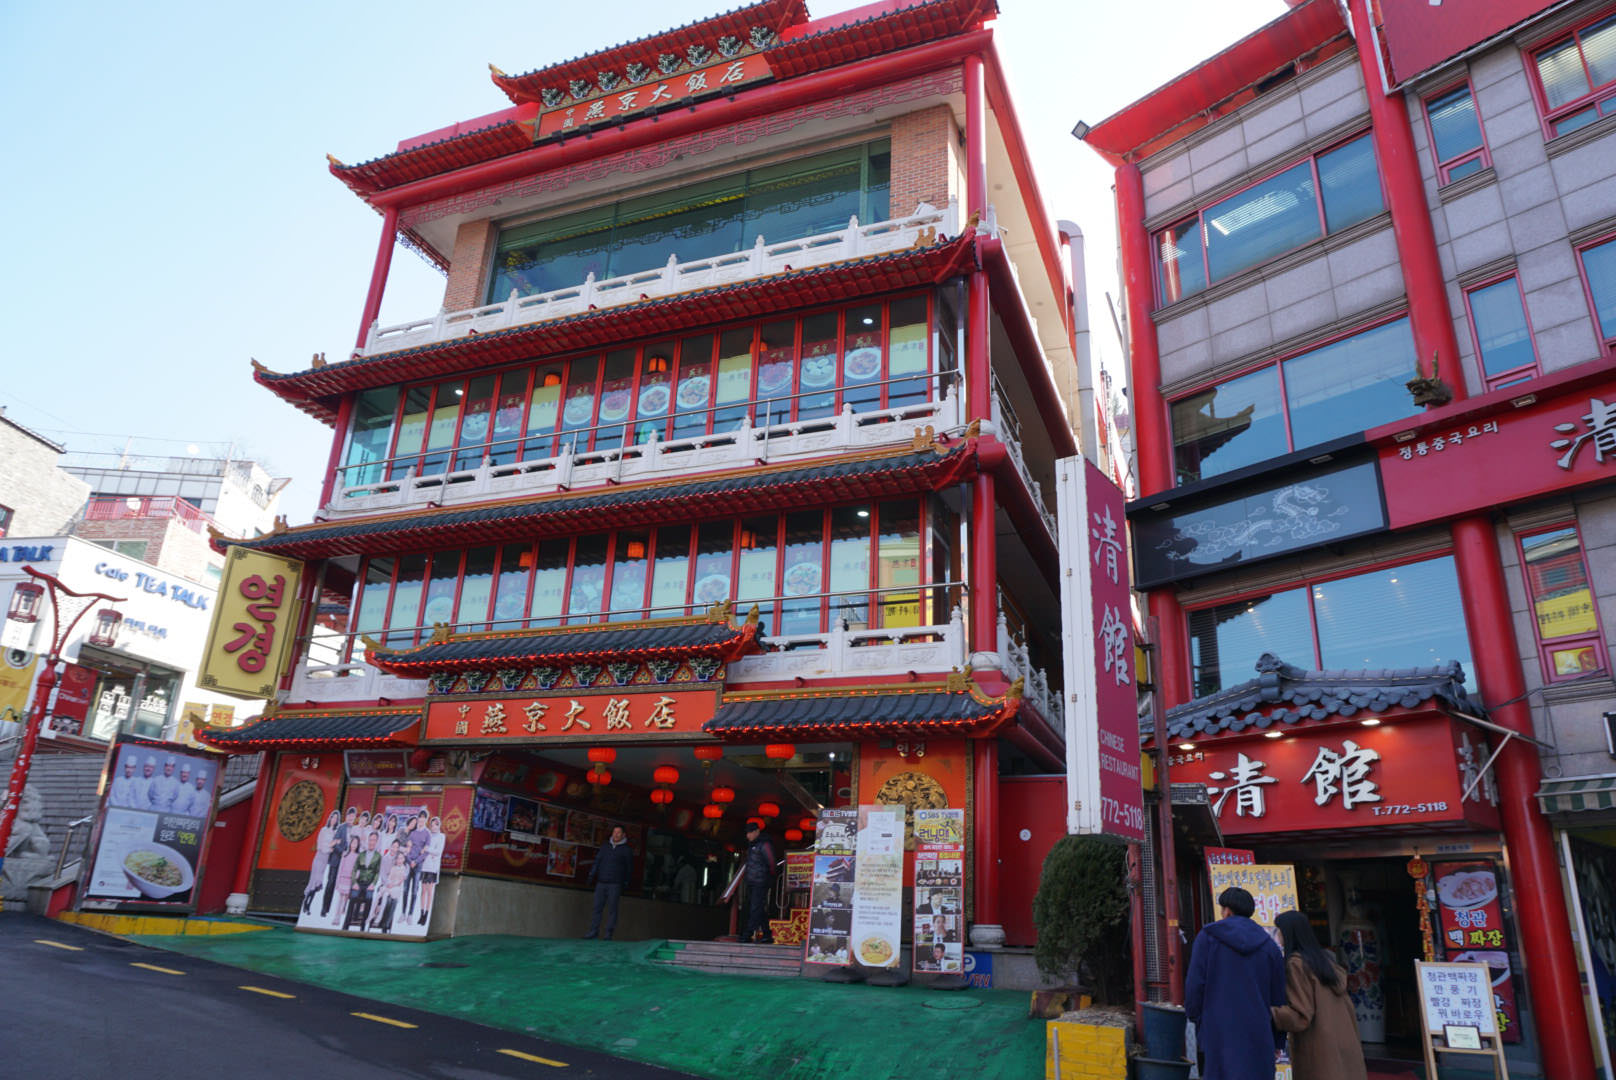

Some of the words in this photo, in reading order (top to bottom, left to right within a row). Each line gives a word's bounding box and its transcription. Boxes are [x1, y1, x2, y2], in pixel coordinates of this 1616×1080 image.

[1399, 421, 1498, 459] 정통중국요리
[12, 545, 54, 561] TALK
[135, 571, 167, 596] TEA
[171, 585, 209, 610] TALK
[223, 574, 285, 673] 연경
[480, 696, 678, 734] 燕京大飯店
[896, 743, 925, 758] 연경
[1100, 728, 1125, 752] CHINESE
[1101, 753, 1138, 781] RESTAURANT
[1102, 797, 1142, 830] 772-5118
[1372, 801, 1448, 816] T.772-5118
[1455, 910, 1487, 928] 청관
[1469, 929, 1504, 946] 짜장
